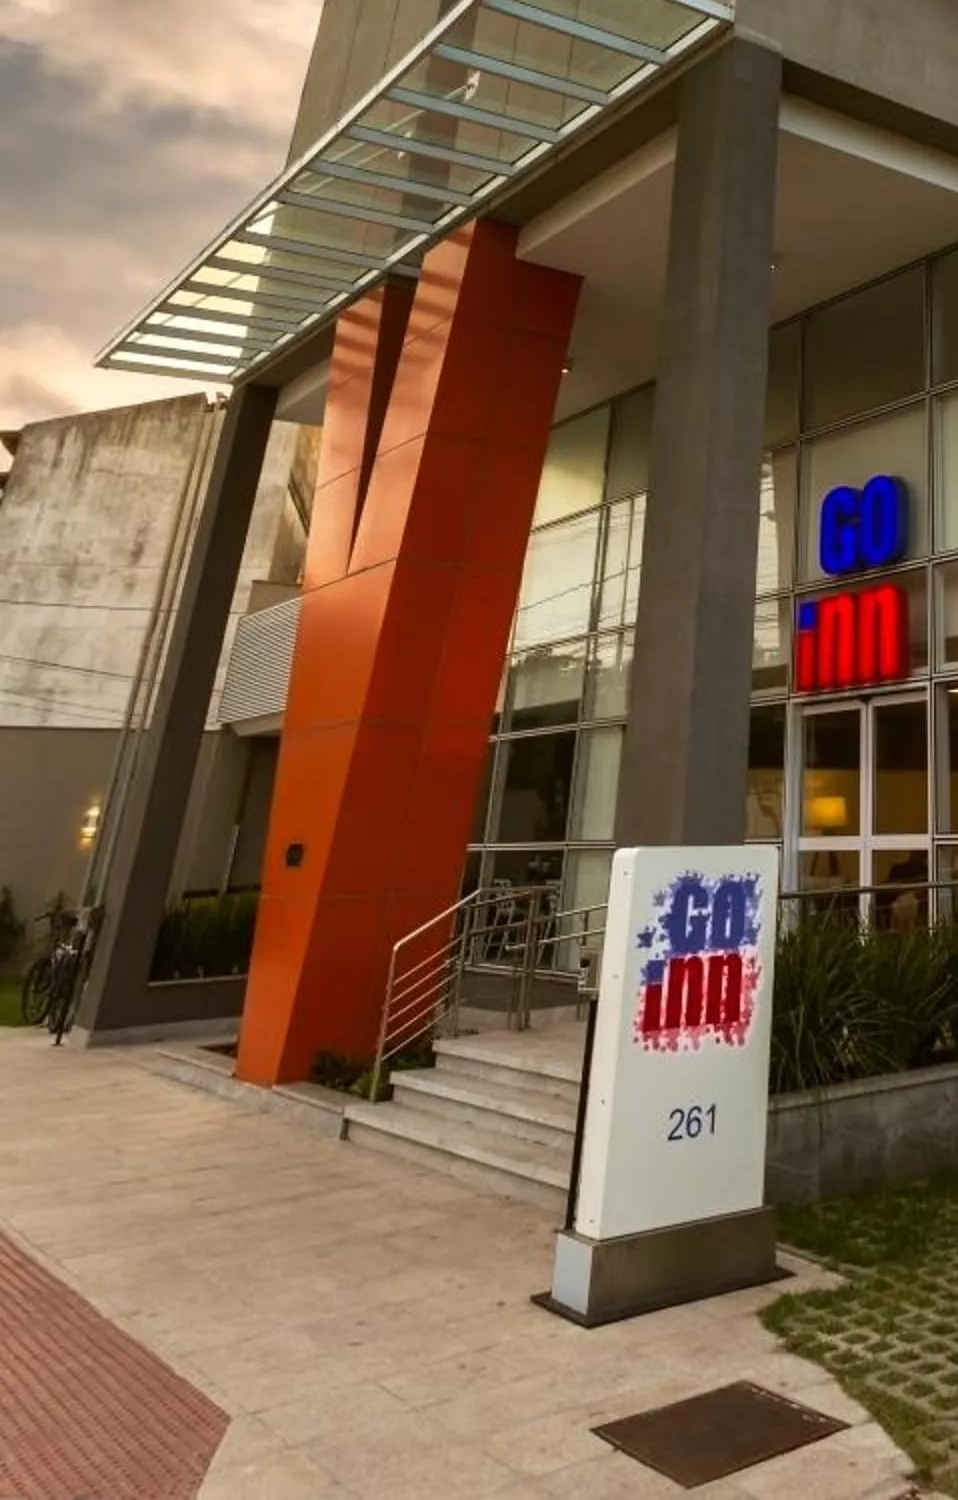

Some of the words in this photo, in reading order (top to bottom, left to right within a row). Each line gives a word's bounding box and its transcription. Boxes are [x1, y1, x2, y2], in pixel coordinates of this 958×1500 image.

[820, 474, 908, 577] GO
[795, 582, 909, 693] inn
[669, 881, 747, 953] GO
[642, 955, 743, 1033] inn
[667, 1103, 717, 1141] 261
